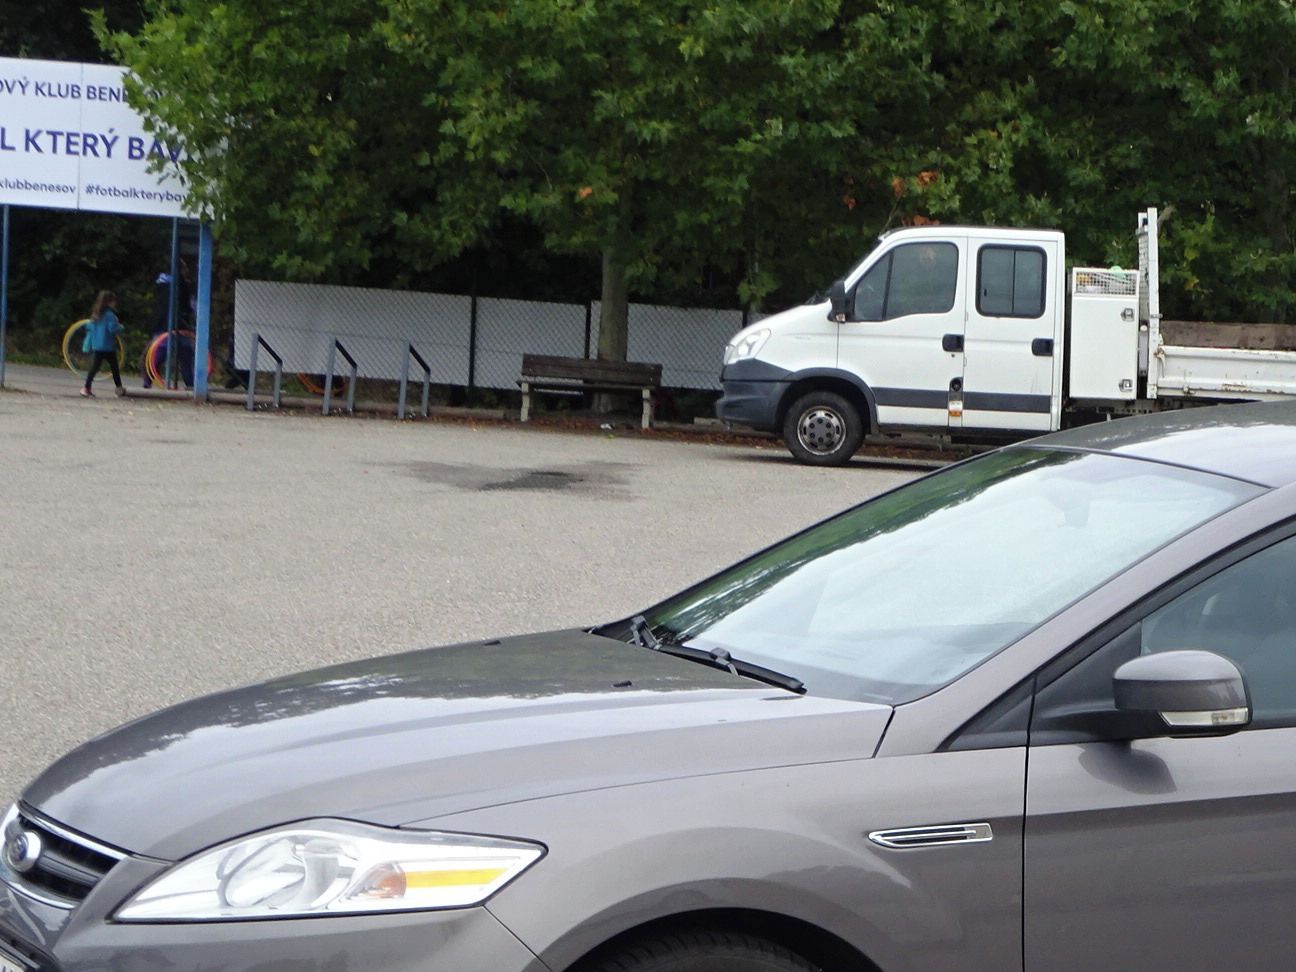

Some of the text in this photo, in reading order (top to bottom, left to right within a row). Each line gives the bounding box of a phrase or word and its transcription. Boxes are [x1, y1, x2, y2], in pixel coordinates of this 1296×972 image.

[0, 76, 30, 96] VÝ
[35, 80, 82, 100] KLUB
[24, 127, 120, 159] KTERÝ
[128, 136, 189, 162] BAV
